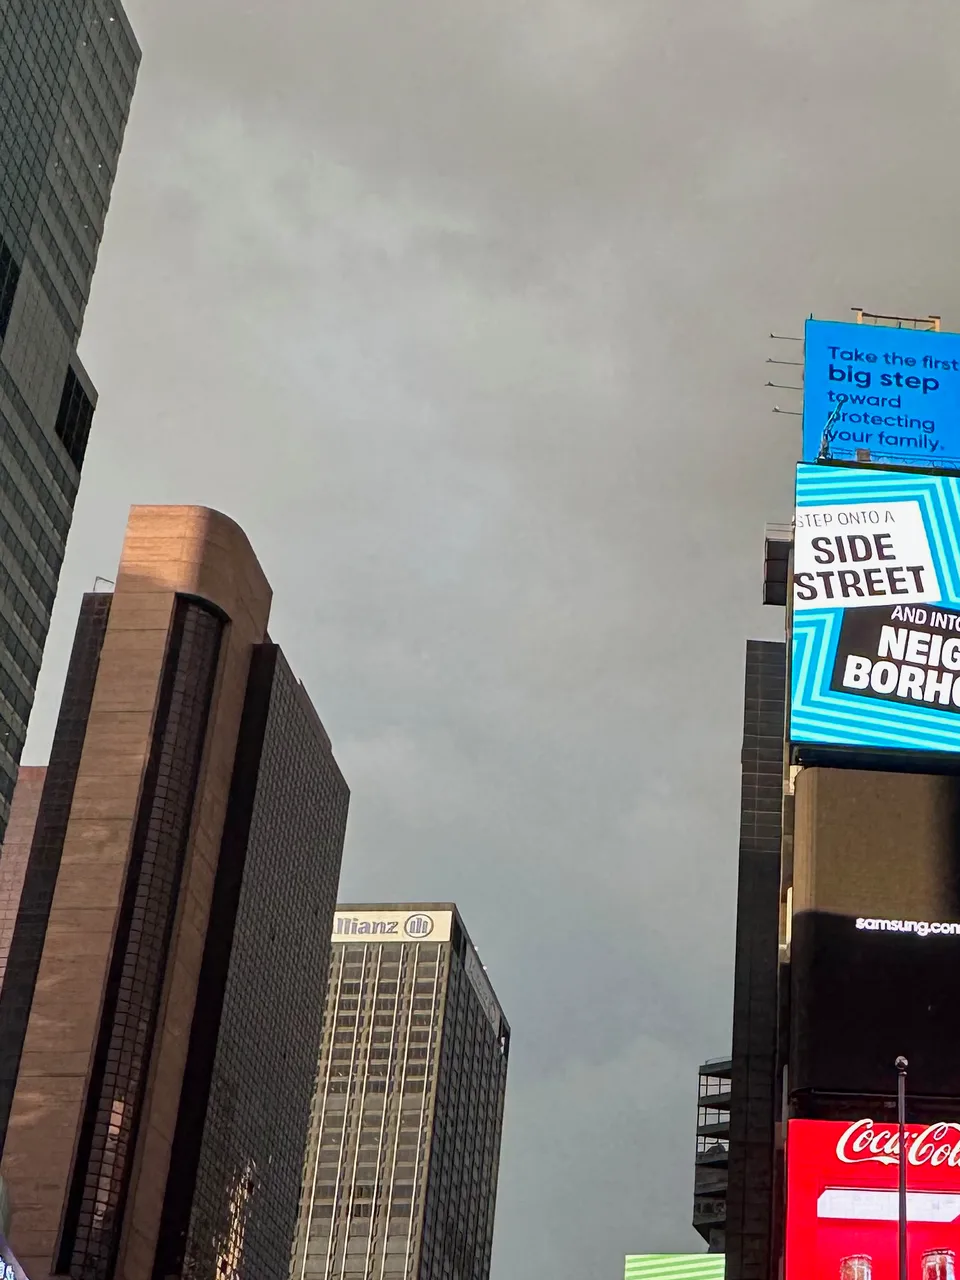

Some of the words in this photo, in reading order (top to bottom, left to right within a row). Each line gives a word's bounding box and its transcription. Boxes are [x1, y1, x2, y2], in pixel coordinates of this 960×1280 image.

[828, 346, 878, 363] Take
[883, 352, 917, 367] the
[922, 355, 960, 371] first
[828, 364, 871, 388] big
[880, 372, 940, 394] step
[827, 390, 901, 408] toward
[828, 411, 935, 434] protecting
[826, 430, 873, 443] your
[878, 431, 945, 452] family.
[797, 513, 833, 528] STEP
[838, 510, 880, 526] ONTO
[884, 510, 896, 523] A
[811, 533, 897, 565] SIDE
[793, 566, 925, 601] STREET
[891, 605, 927, 625] AND
[333, 917, 399, 935] llianz
